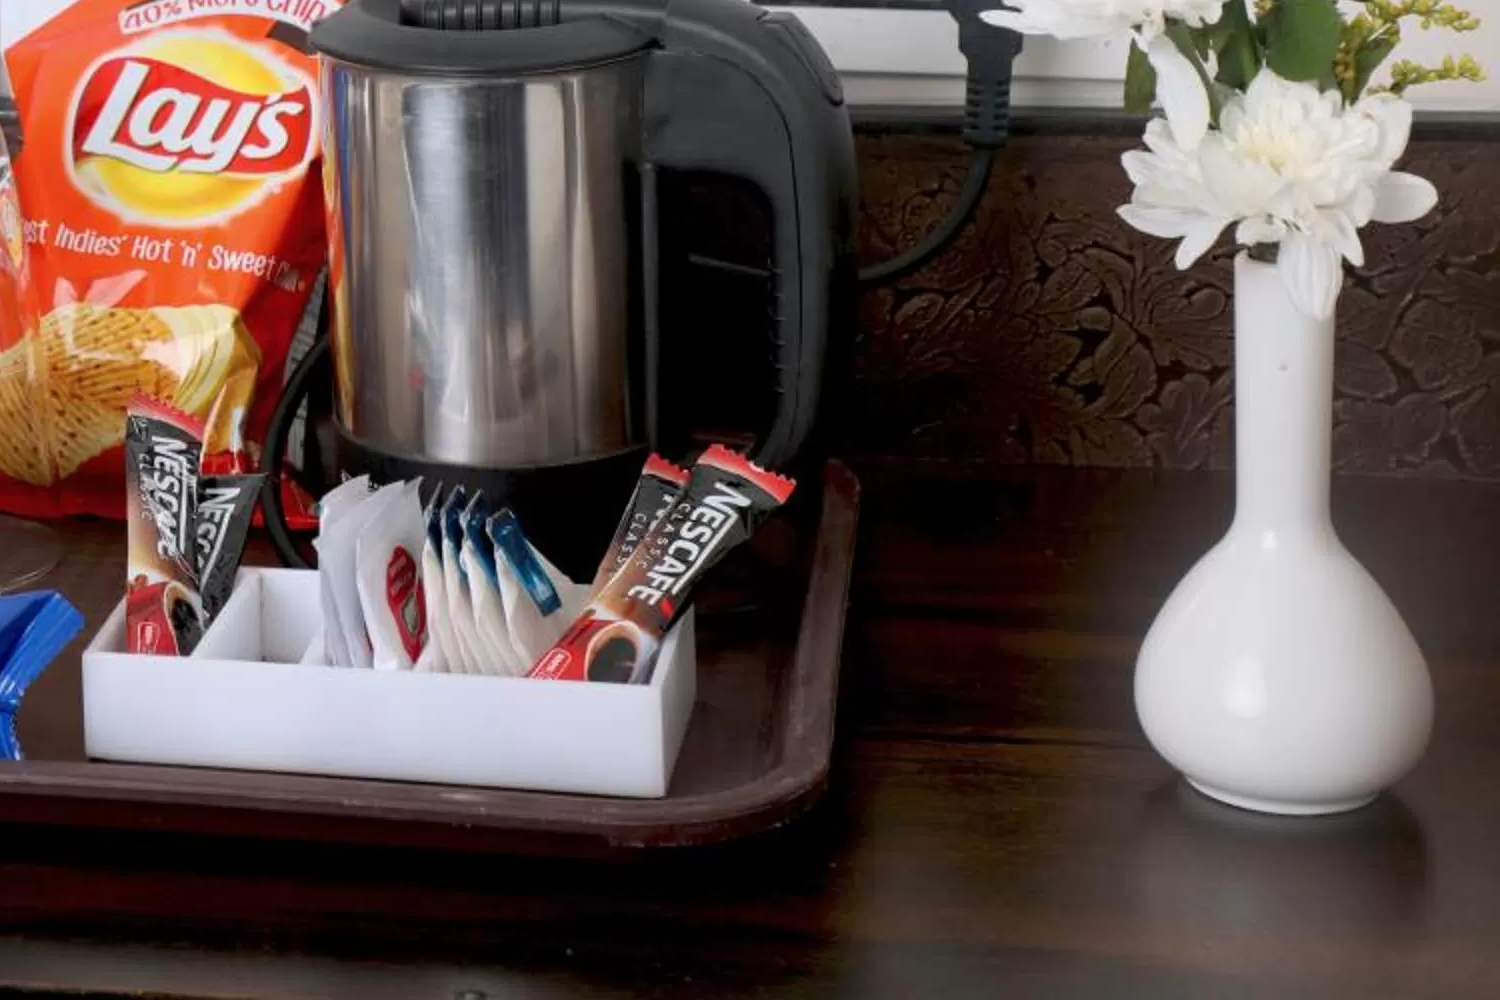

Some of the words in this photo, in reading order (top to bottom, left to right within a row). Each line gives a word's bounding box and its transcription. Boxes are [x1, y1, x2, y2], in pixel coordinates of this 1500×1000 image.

[124, 3, 183, 29] 40%
[81, 60, 305, 174] Lay's
[131, 235, 173, 263] Hot
[208, 244, 276, 277] Sweet
